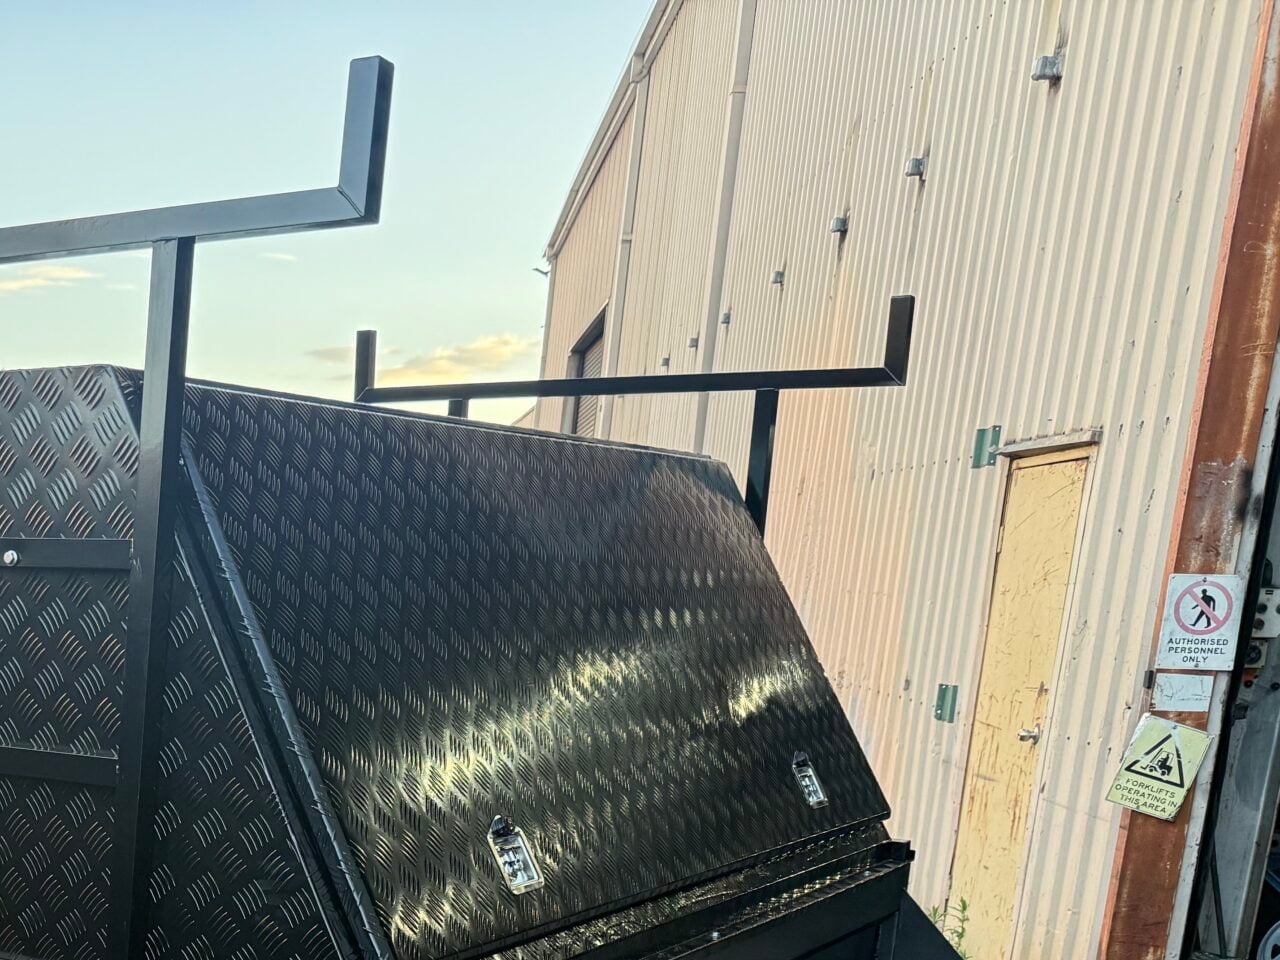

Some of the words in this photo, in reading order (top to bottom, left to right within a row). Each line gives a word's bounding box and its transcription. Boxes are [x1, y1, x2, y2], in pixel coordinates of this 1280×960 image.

[1167, 637, 1229, 646] AUTHORISED
[1168, 646, 1226, 655] PERSONNEL
[1182, 655, 1209, 663] ONLY
[1114, 783, 1167, 805] OPERATING
[1167, 800, 1178, 808] IN
[1125, 778, 1176, 799] FORKLIFTS
[1120, 793, 1140, 806] THIS
[1140, 801, 1166, 814] AREA
